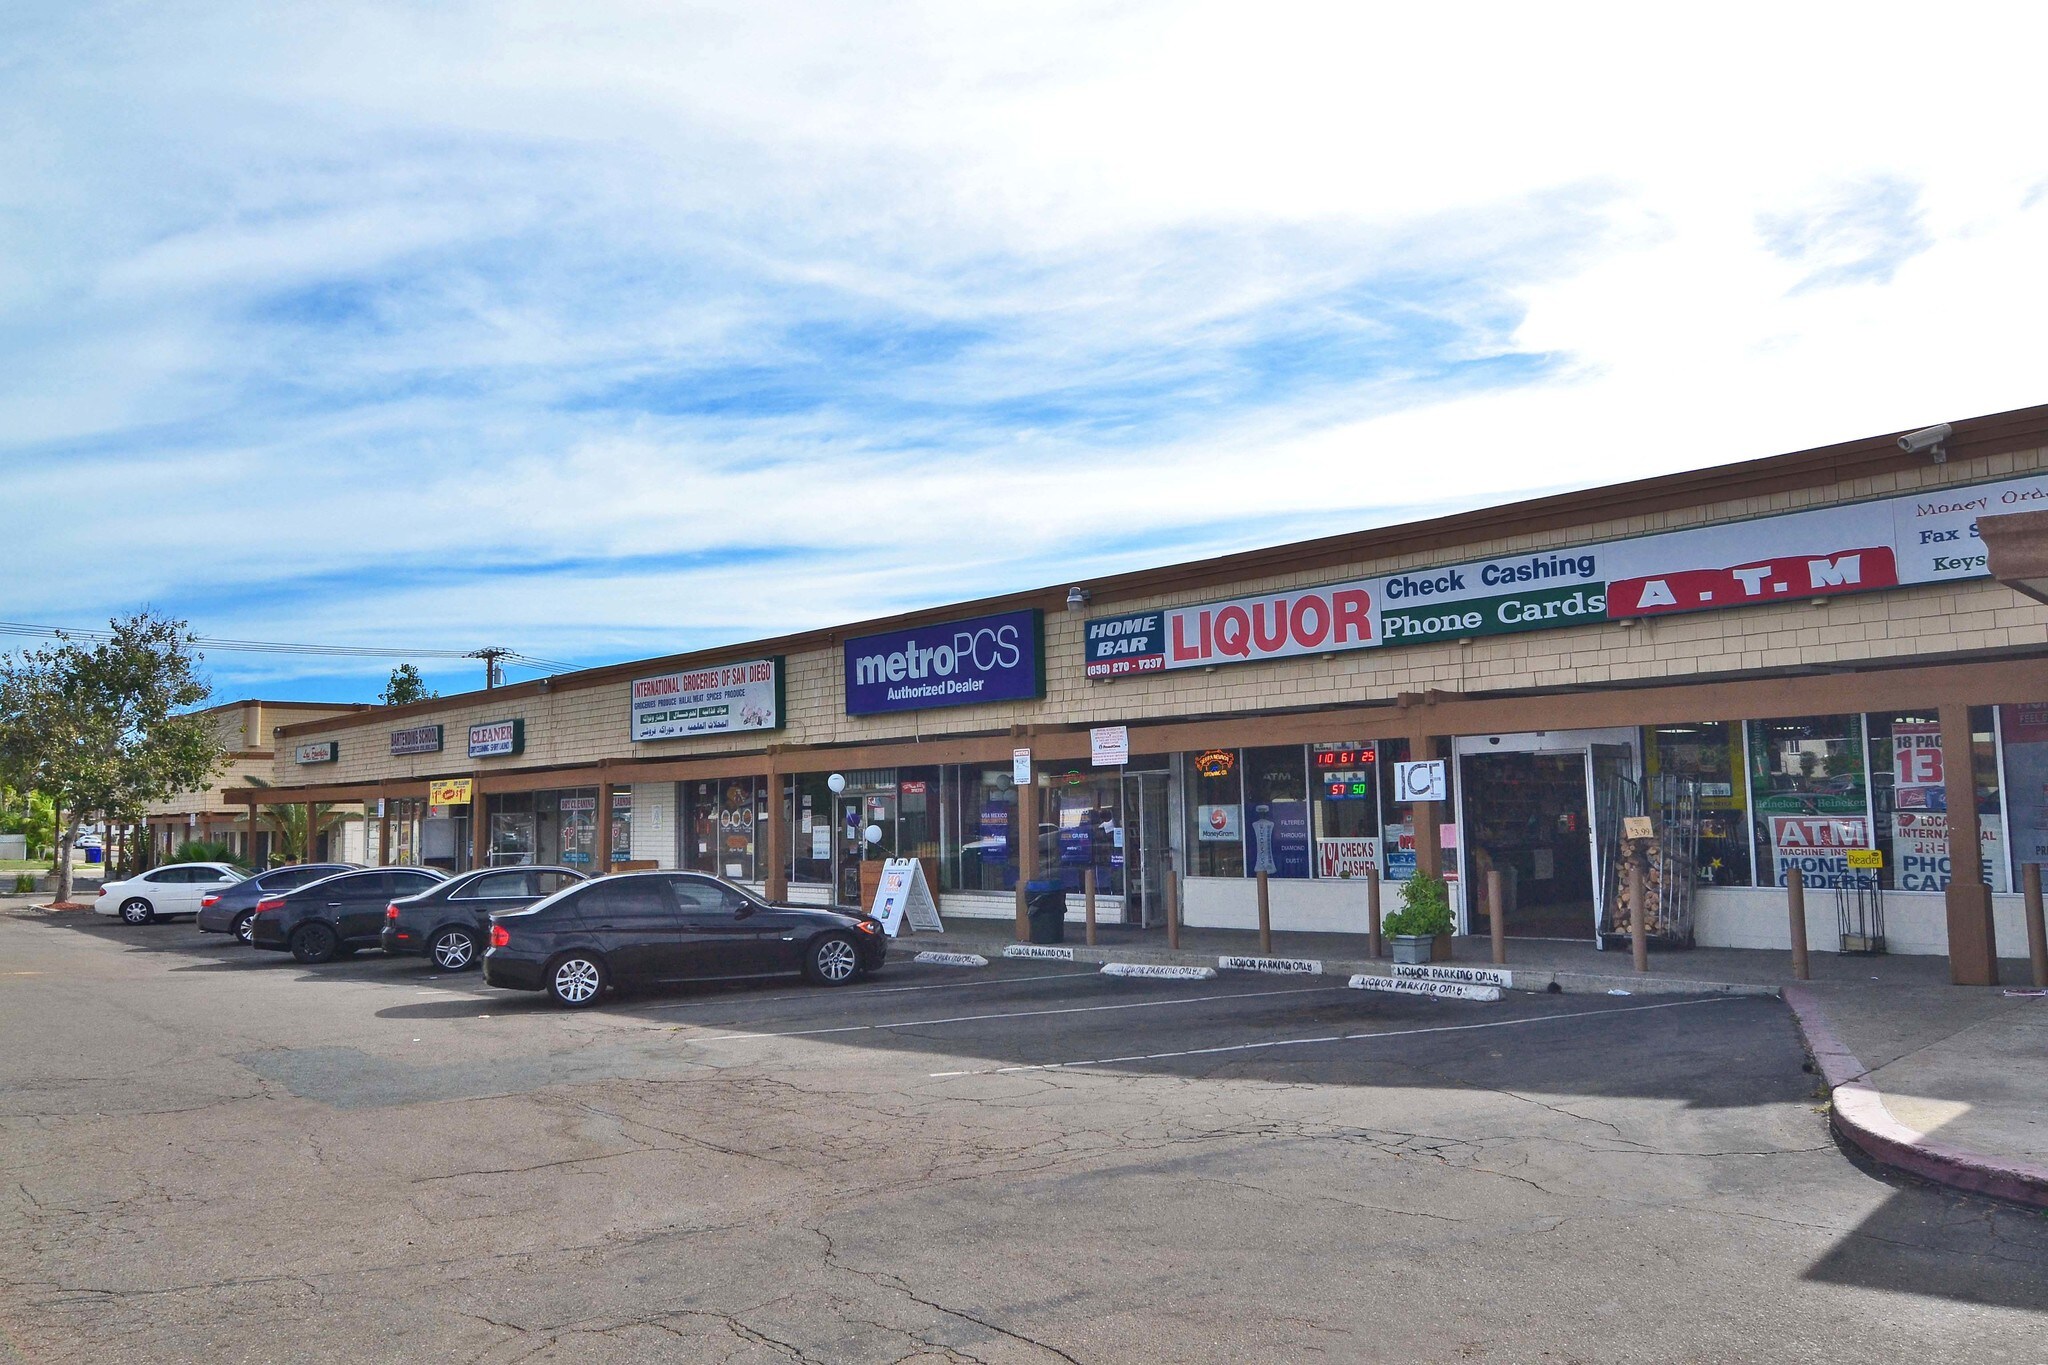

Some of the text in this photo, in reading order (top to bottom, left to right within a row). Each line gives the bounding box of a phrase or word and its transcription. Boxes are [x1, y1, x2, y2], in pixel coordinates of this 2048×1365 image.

[1916, 488, 2048, 517] Money Ord
[1919, 523, 1981, 545] Fax S
[1932, 555, 1987, 573] Keys
[1386, 555, 1595, 600] Check Cashing
[1382, 592, 1606, 639] Phone Cards
[1089, 616, 1158, 639] HOME
[1172, 589, 1372, 661] LIQUOR
[856, 624, 1020, 686] metroPCS
[1096, 637, 1148, 657] BAR
[634, 662, 771, 698] INTERNATIONAL GROCERIES OF SAN DIEGO
[887, 678, 984, 701] Authorized Dealer
[634, 701, 656, 710] GROCERIES
[657, 697, 677, 707] PRODUCE
[706, 691, 722, 701] SPICES
[724, 688, 746, 699] PRODUCE
[391, 727, 437, 746] BARTENDING SCHOOL
[472, 726, 512, 744] CLEANER
[1895, 735, 1943, 749] 18 PAC
[1361, 751, 1374, 762] 25
[1896, 748, 1944, 783] 13
[1332, 784, 1365, 795] 57 50
[1401, 762, 1442, 800] ICE
[1756, 799, 1867, 809] Heineken Heineken
[1921, 816, 1949, 827] LOCA
[1202, 830, 1235, 838] MoneyGram
[1399, 834, 1415, 850] OPE
[1779, 821, 1865, 846] ATM
[1898, 828, 1997, 841] INTERNAAL
[1341, 842, 1374, 858] CHECKS
[1780, 848, 1825, 856] MACHINE
[1848, 853, 1881, 865] Reader
[1342, 860, 1376, 876] CASHED
[1903, 855, 1993, 873] PHOE
